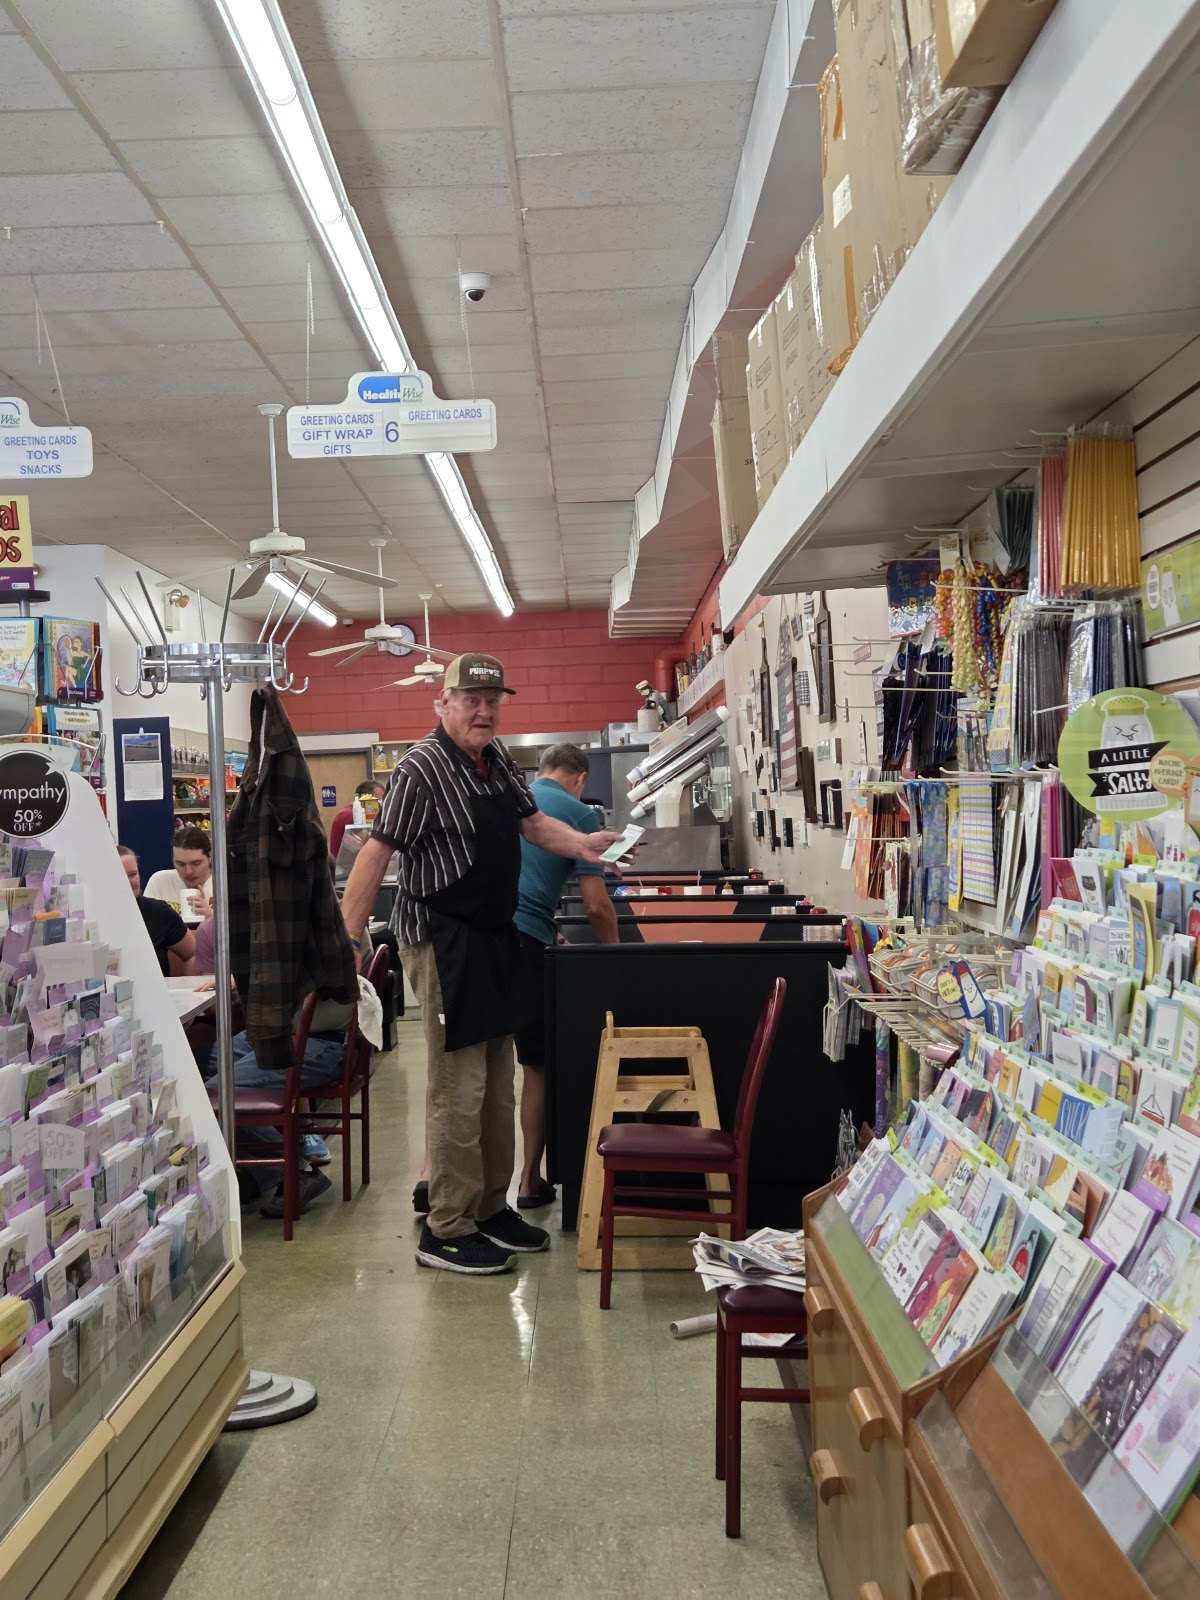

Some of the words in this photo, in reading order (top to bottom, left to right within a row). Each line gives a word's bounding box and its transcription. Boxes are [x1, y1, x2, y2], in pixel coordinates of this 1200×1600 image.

[402, 387, 423, 399] Wise
[0, 414, 20, 425] Wise
[300, 415, 343, 426] GREETING
[345, 413, 375, 425] CARDS
[408, 409, 451, 421] GREETING
[453, 408, 482, 419] CARDS
[302, 430, 331, 441] GIFT
[334, 429, 373, 440] WRAP
[385, 421, 399, 443] 6
[4, 436, 47, 446] GREETING
[48, 435, 77, 445] CARDS
[26, 450, 60, 460] TOYS
[323, 444, 352, 455] GIFTS
[20, 464, 62, 475] SNACKS
[1101, 753, 1110, 763] A
[1112, 748, 1151, 762] LITTLE
[1153, 768, 1184, 777] AVERAGE
[13, 806, 43, 823] 50%
[45, 1129, 75, 1148] 50%
